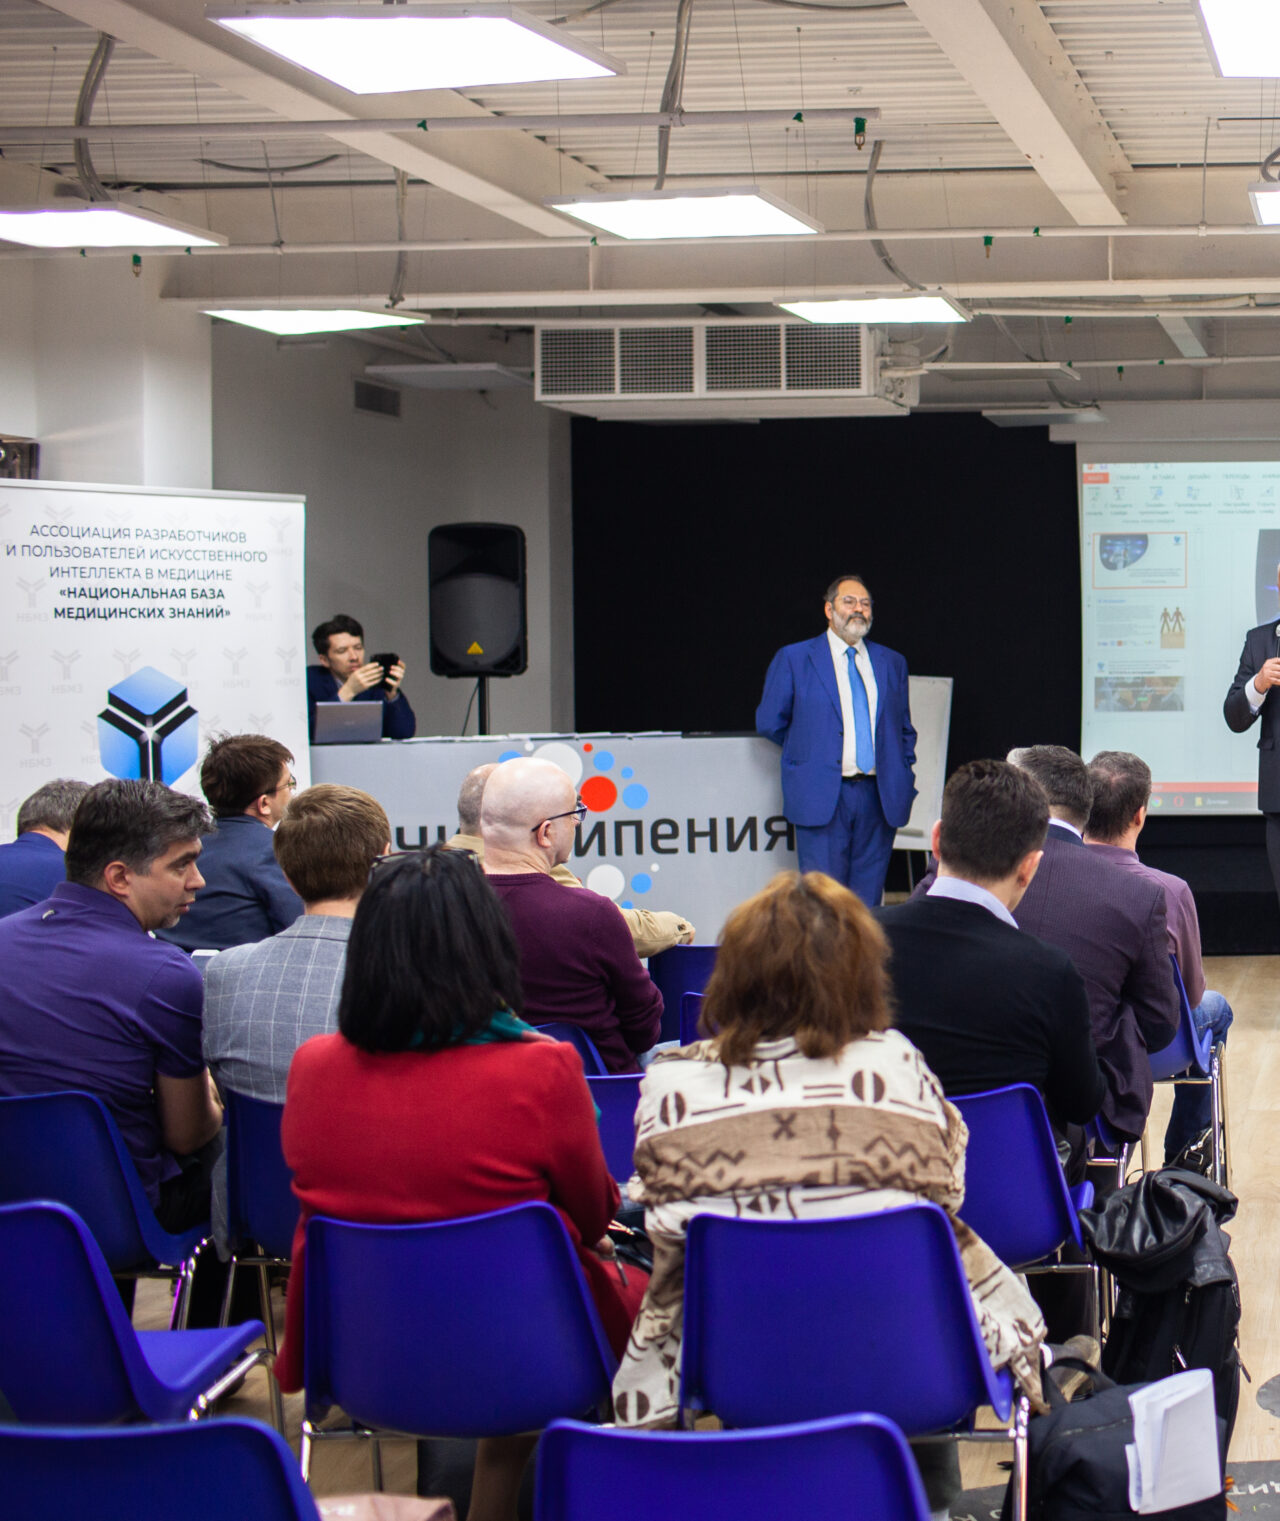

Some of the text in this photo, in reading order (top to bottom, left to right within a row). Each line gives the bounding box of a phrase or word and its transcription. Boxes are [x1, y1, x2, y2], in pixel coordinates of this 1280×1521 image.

[30, 524, 247, 543] АССОЦИАЦИЯ РАЗРАБОТЧИКОВ
[6, 543, 17, 557] И
[21, 544, 146, 560] ПОЛЬЗОВАТЕЛЕЙ
[150, 548, 268, 563] ИСКУССТВЕННОГО
[49, 565, 233, 581] ИНТЕЛЛЕКТА В МЕДИЦИНЕ
[59, 586, 226, 600] «НАЦИОНАЛЬНАЯ БАЗА
[54, 605, 231, 621] МЕДИЦИНСКИХ ЗНАНИЙ»
[574, 815, 796, 858] ипения
